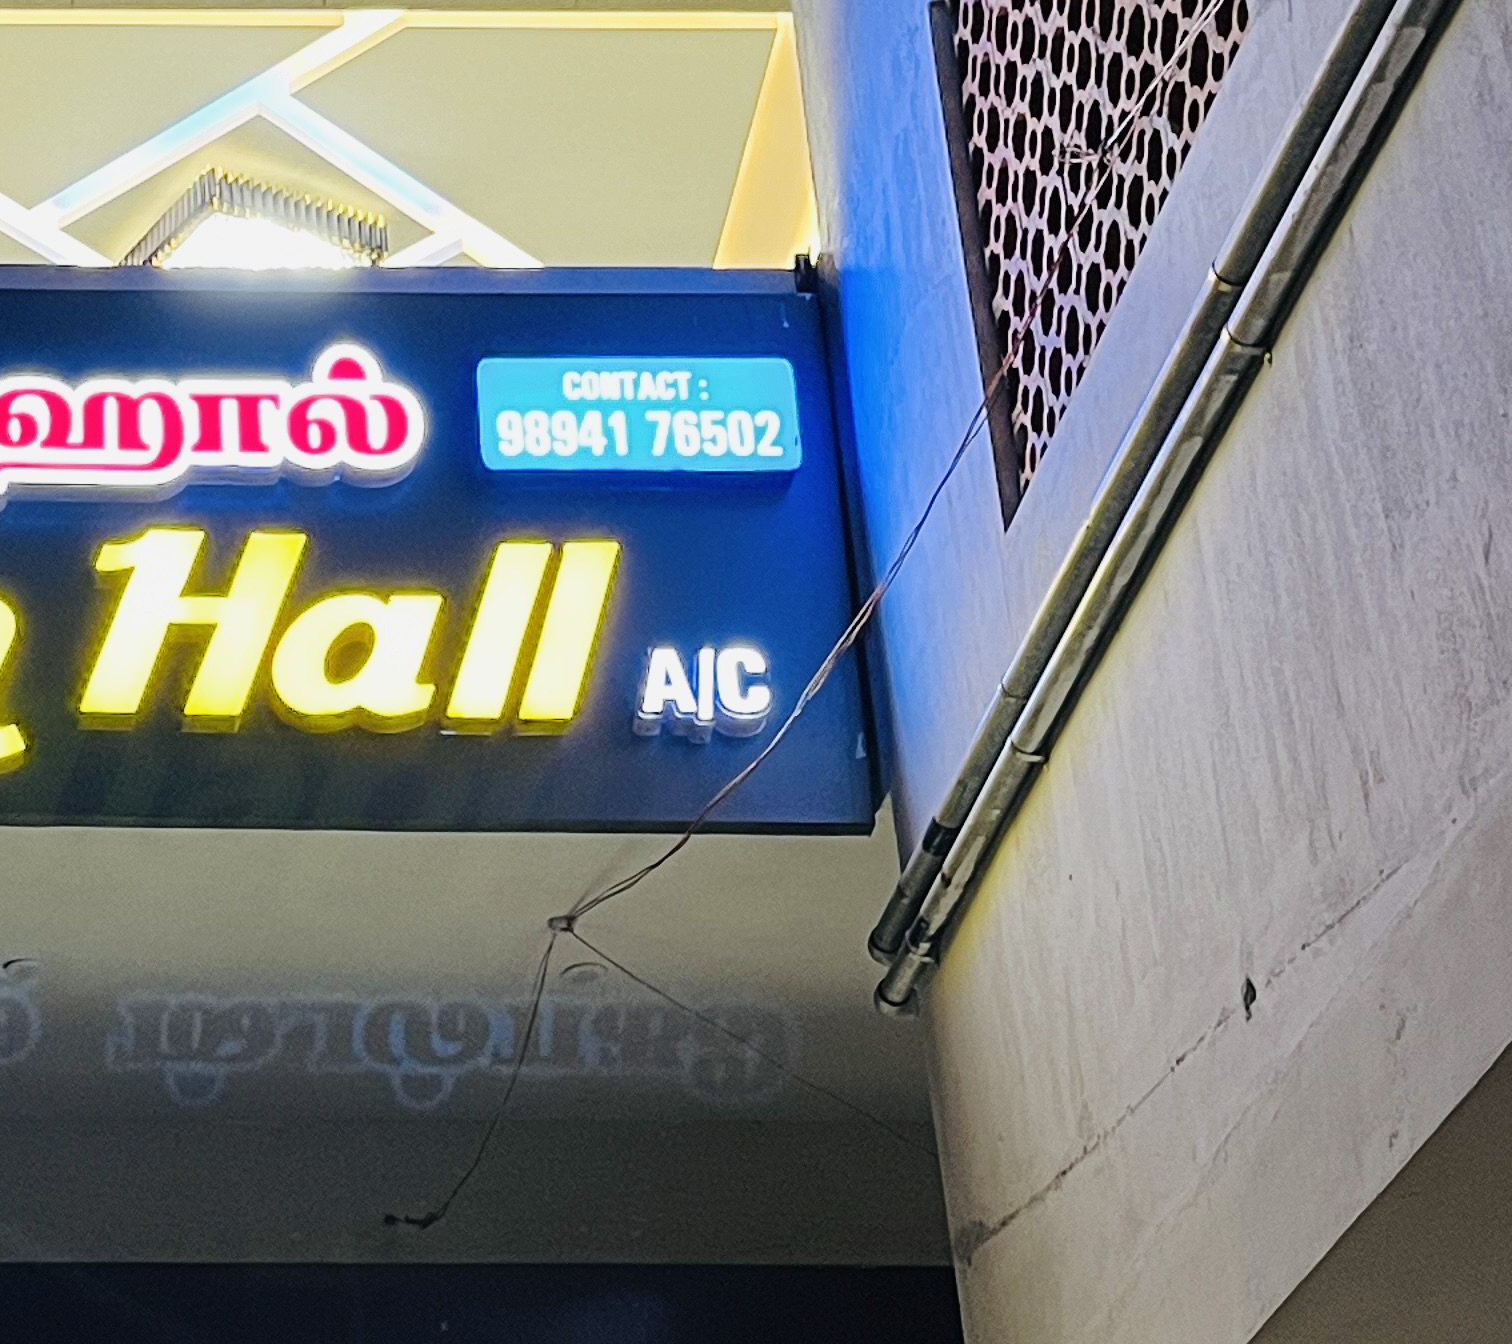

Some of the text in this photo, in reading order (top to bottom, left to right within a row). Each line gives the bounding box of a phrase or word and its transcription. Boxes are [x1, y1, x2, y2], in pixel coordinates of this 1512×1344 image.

[495, 409, 784, 457] 98941 76502
[78, 527, 621, 723] Hall
